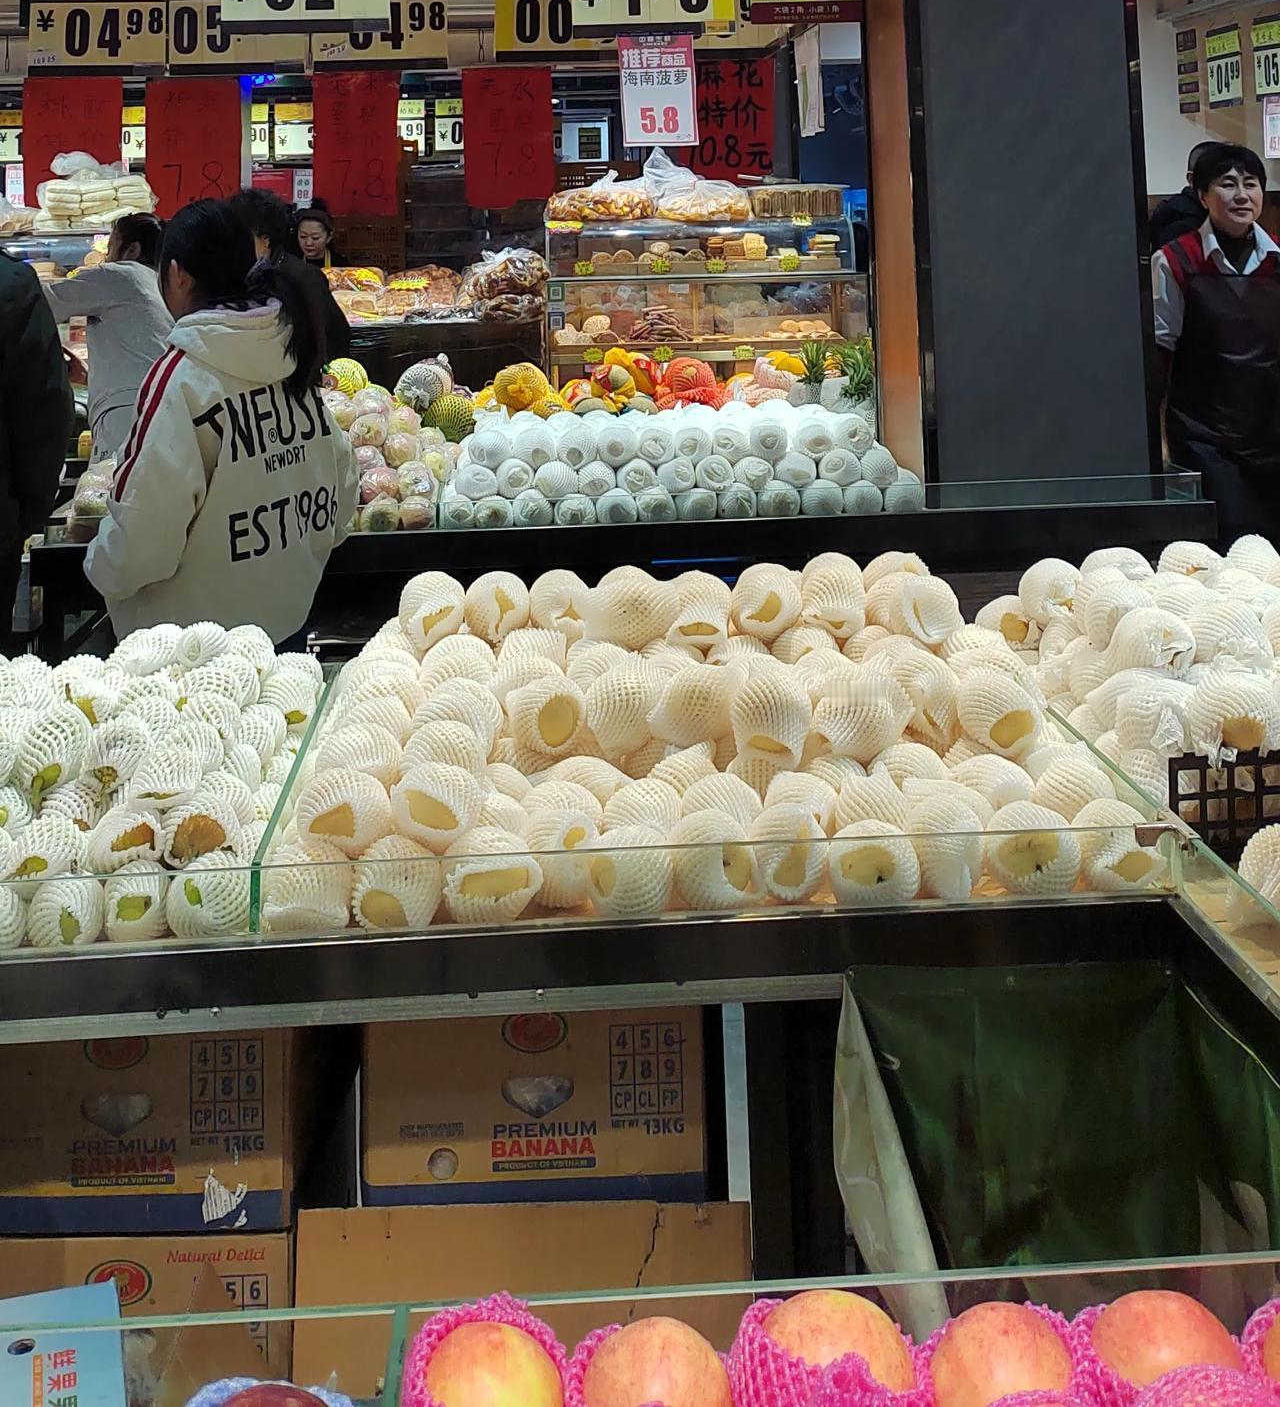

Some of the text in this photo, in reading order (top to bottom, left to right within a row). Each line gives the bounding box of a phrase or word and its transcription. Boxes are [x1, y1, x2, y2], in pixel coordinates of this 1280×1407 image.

[621, 48, 686, 68] 推荐 商品
[623, 69, 689, 86] 海南菠萝
[639, 106, 680, 134] 5.8
[698, 94, 768, 136] 特价
[228, 496, 291, 563] EST
[616, 1029, 676, 1049] 4 5 6
[197, 1045, 256, 1066] 4 5 6
[617, 1058, 675, 1080] 7 8 9
[197, 1075, 256, 1096] 7 8 9
[615, 1089, 679, 1110] CP CL FP
[194, 1106, 259, 1126] CP CL FP
[643, 1117, 685, 1135] 13KG
[493, 1120, 597, 1139] PREMIUM
[72, 1137, 177, 1155] PREMIUM
[491, 1137, 596, 1159] BANANA
[167, 1249, 222, 1264] Natural
[250, 1280, 262, 1300] 6
